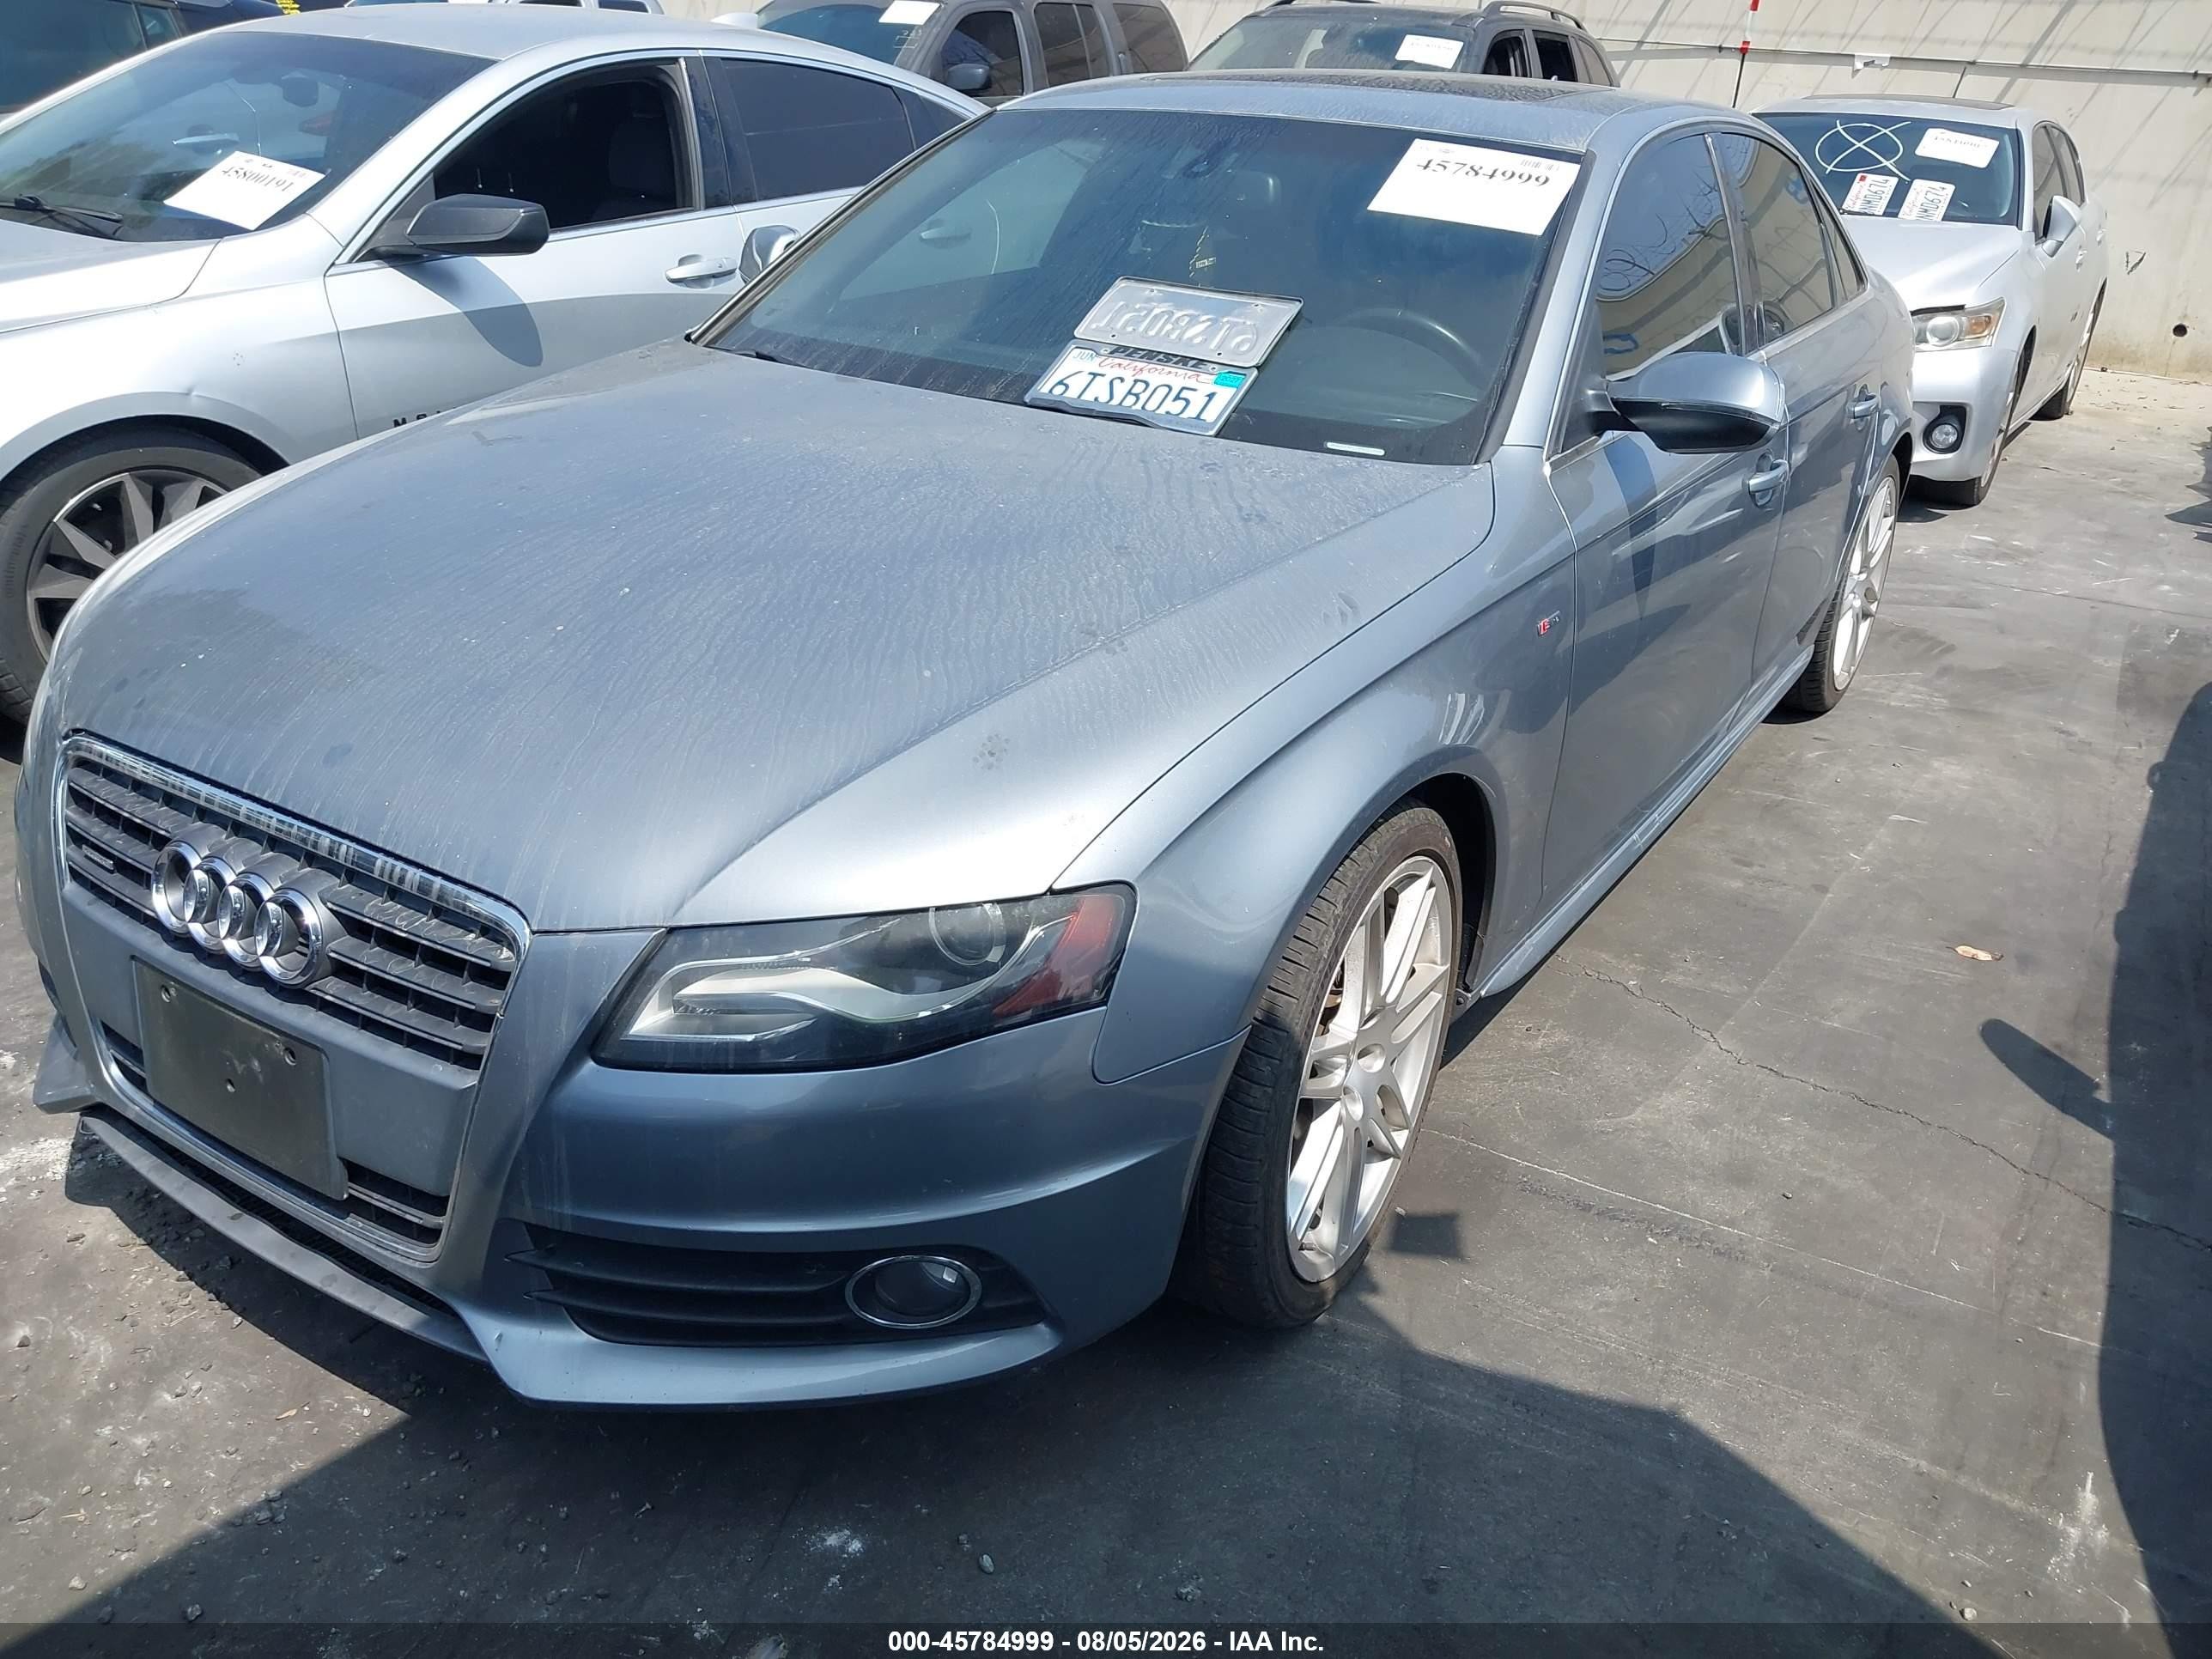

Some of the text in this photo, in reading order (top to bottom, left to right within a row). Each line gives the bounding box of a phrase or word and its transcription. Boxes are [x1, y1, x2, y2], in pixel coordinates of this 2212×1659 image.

[1416, 158, 1551, 186] 45784999
[1073, 349, 1097, 363] JUN
[1098, 356, 1212, 384] California
[1108, 345, 1207, 369] PENSKE
[1048, 370, 1218, 422] 6TSB051
